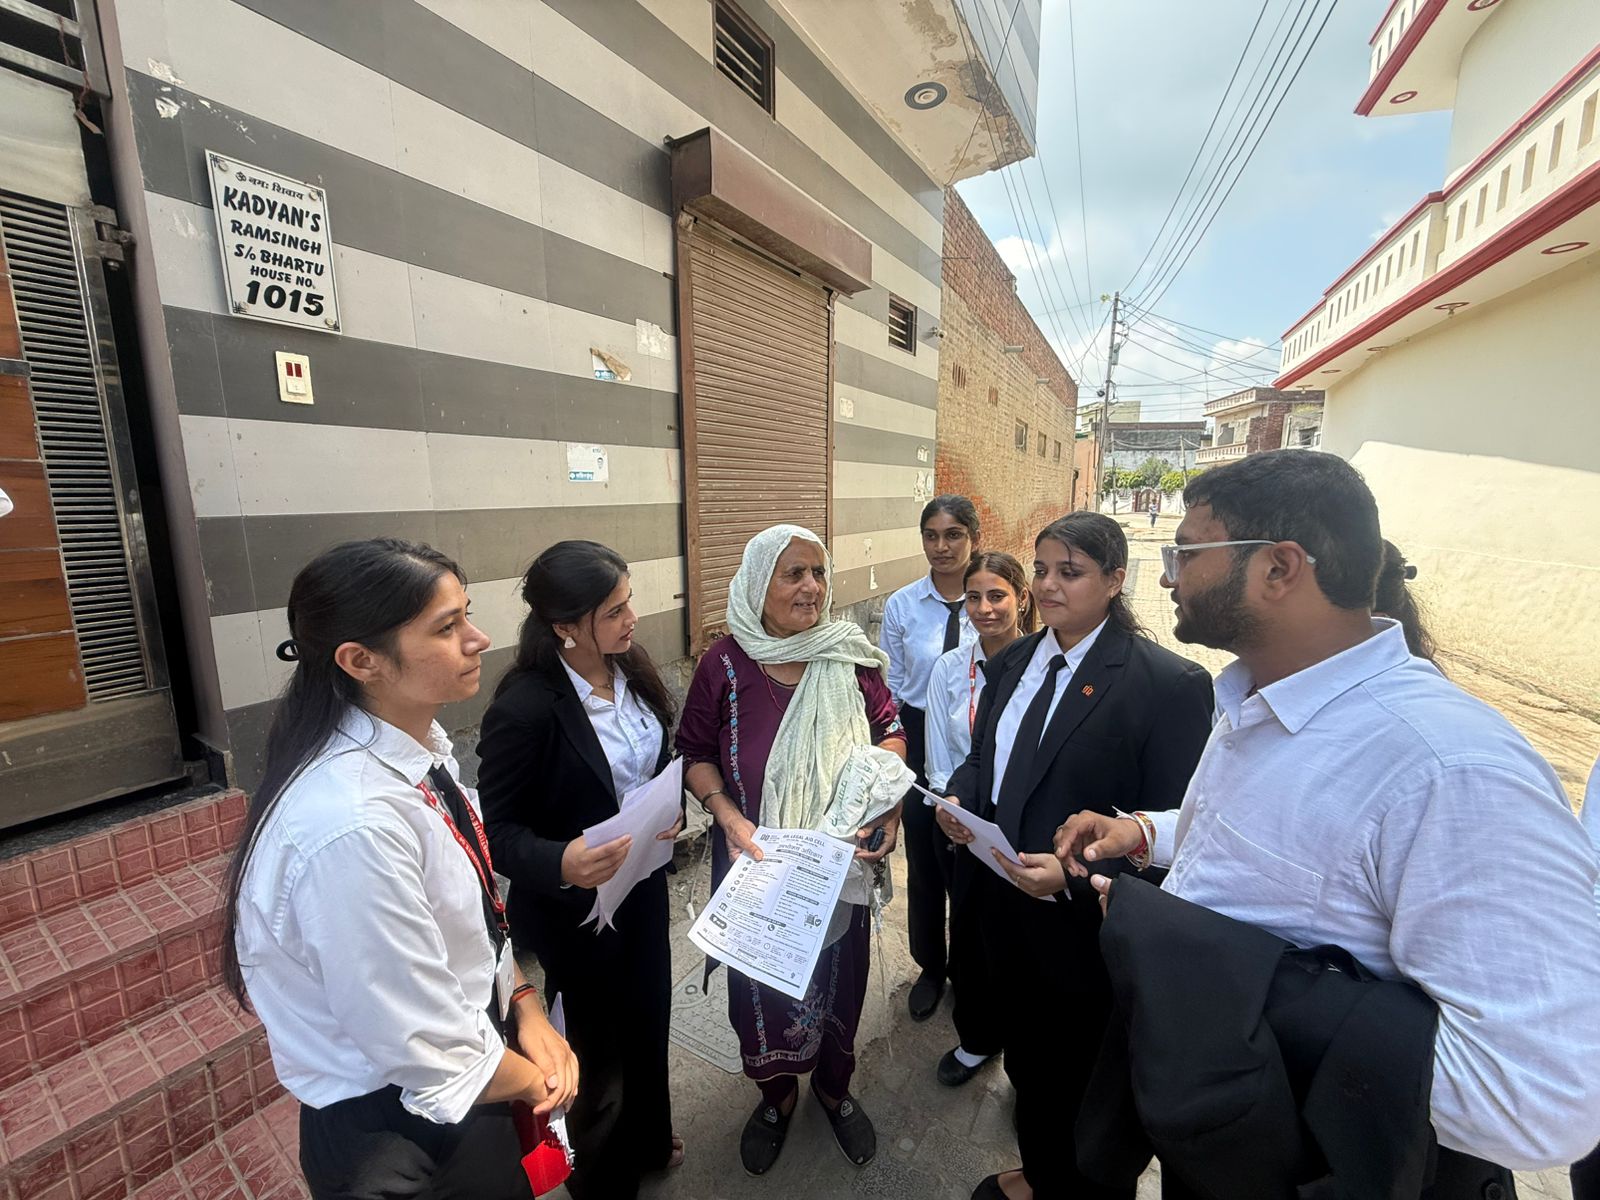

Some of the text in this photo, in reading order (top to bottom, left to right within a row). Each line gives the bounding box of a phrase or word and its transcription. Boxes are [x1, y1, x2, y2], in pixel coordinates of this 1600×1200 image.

[249, 177, 269, 190] नमः
[272, 183, 306, 200] शिवाय
[223, 185, 321, 233] KADYAN'S
[230, 219, 321, 255] RAMSINGH
[260, 249, 325, 276] BHARTU
[250, 265, 316, 290] HOUSE NO.
[246, 280, 325, 317] 1015
[814, 838, 825, 846] CELL
